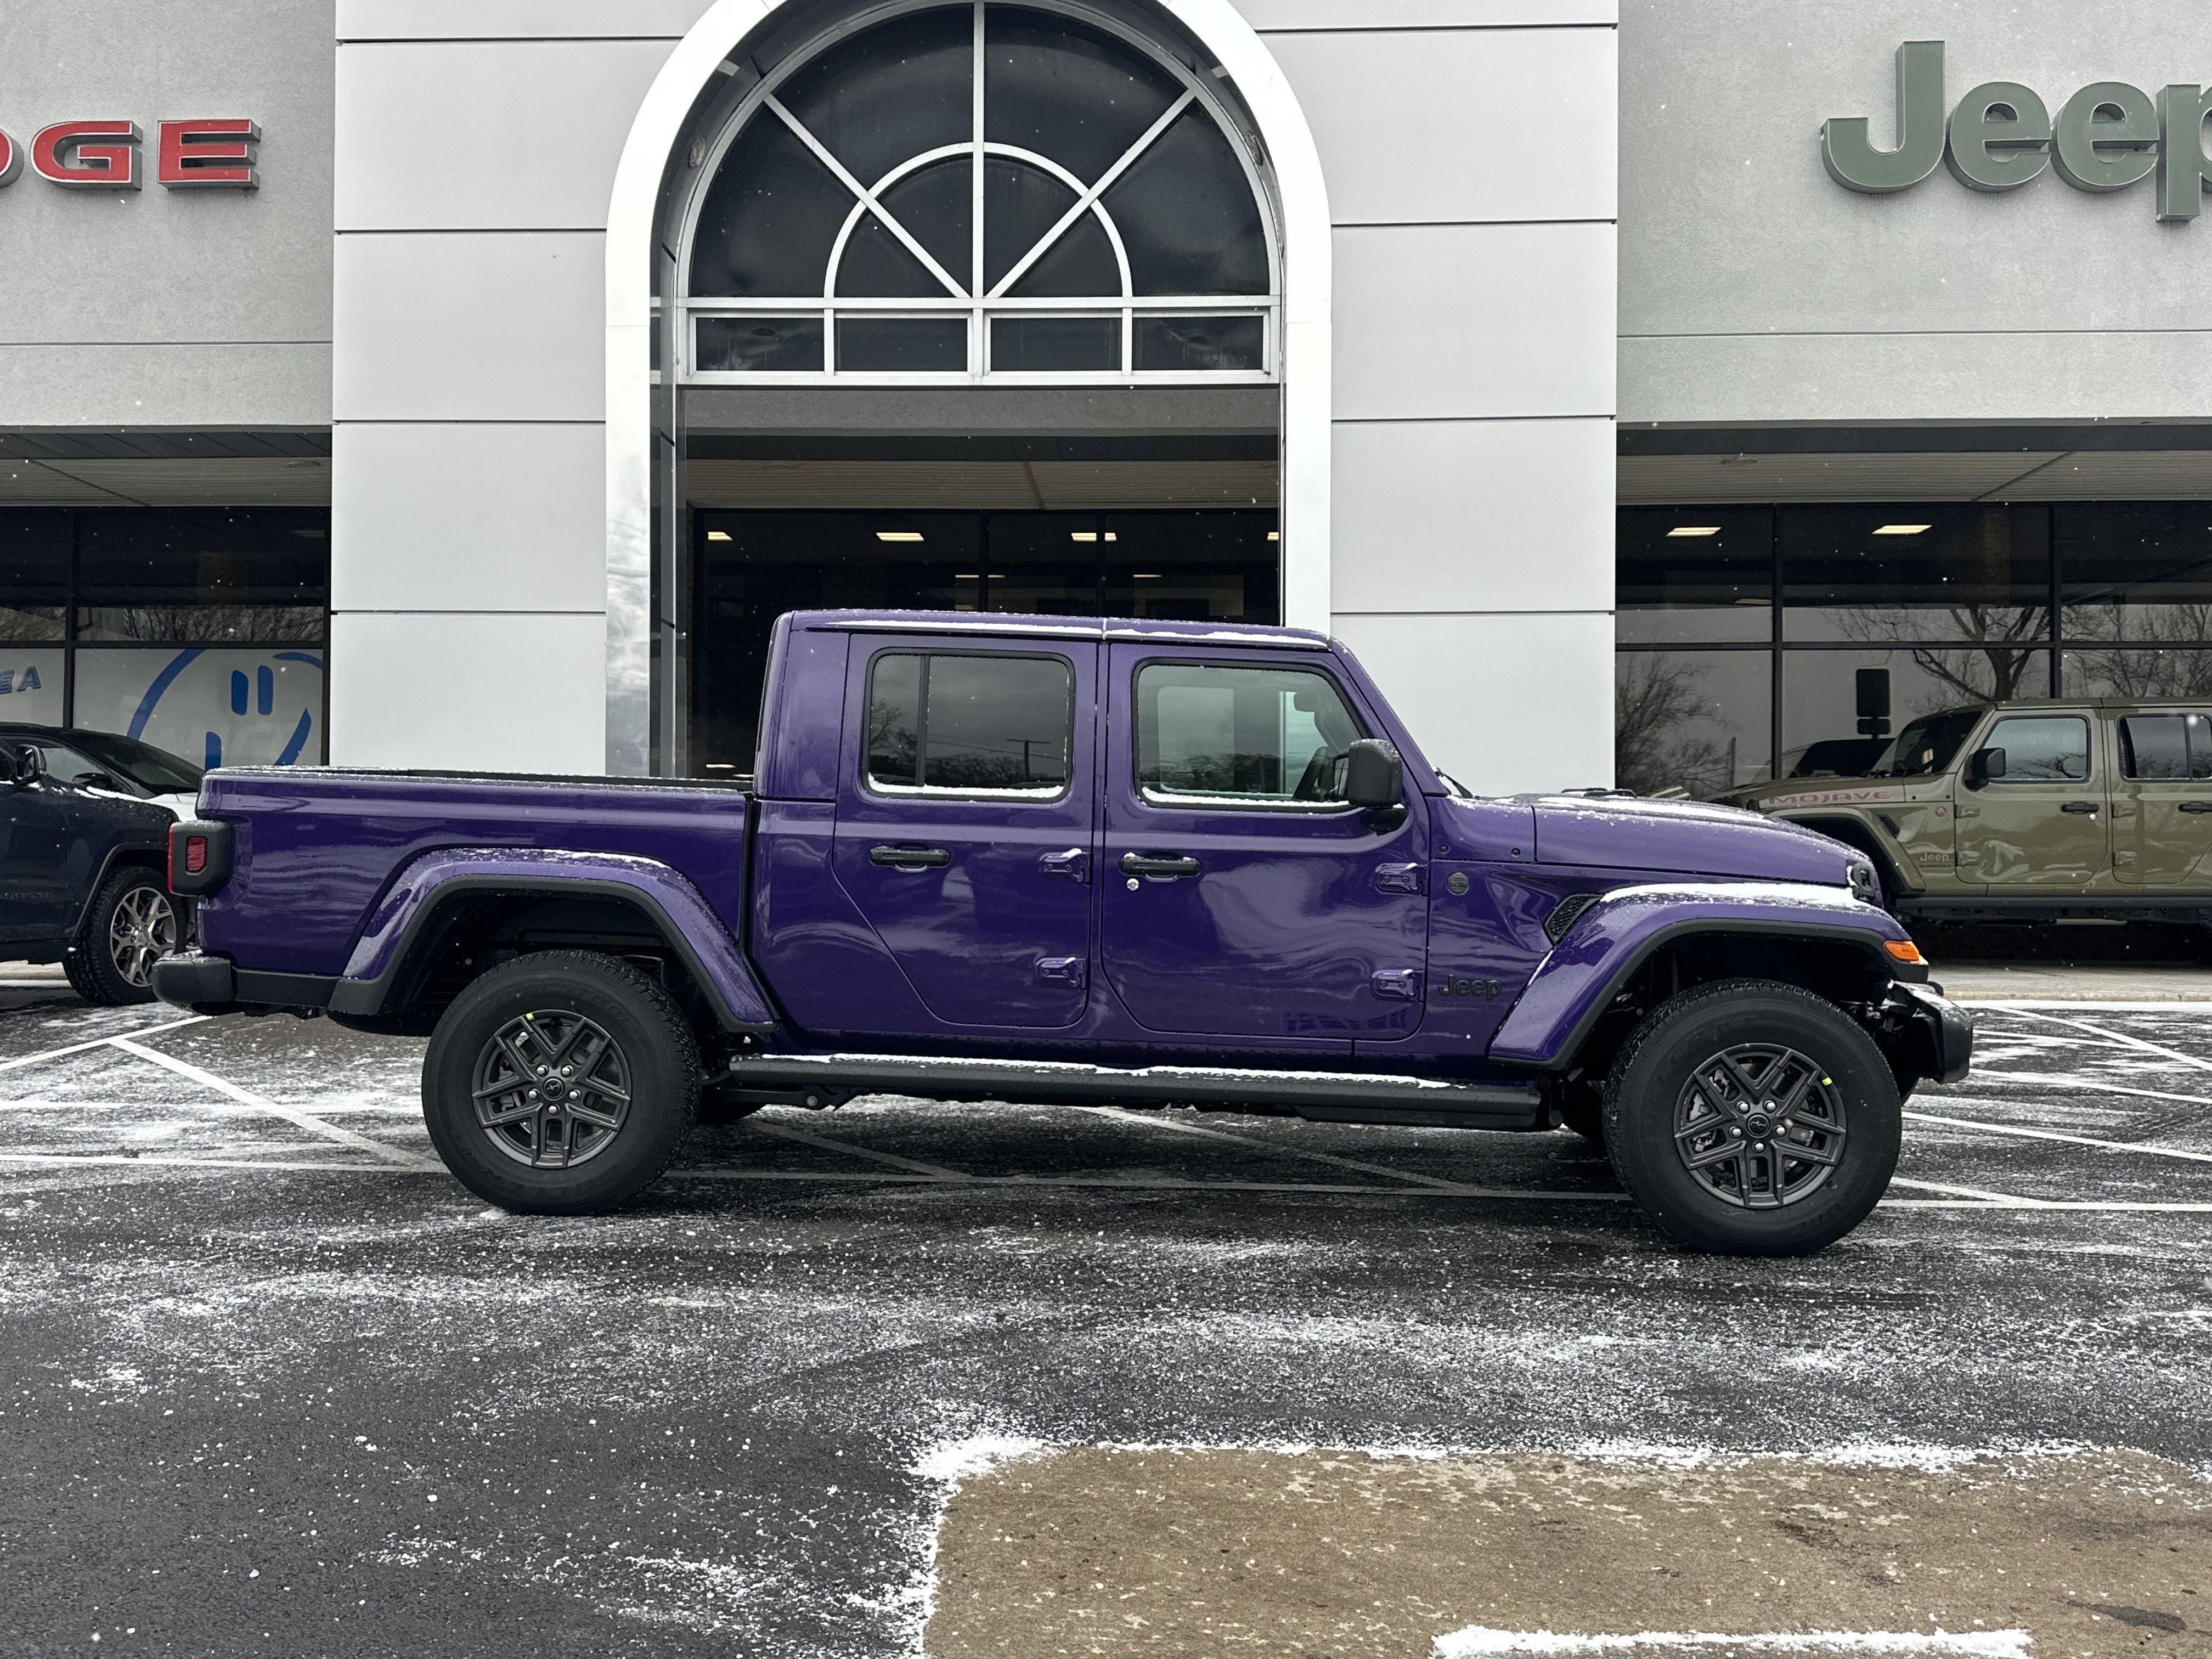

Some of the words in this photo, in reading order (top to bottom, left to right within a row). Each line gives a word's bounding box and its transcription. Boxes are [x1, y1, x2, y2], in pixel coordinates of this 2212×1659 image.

[1767, 791, 1891, 805] MOJAVE
[1920, 852, 1949, 863] Jeep
[1438, 974, 1502, 1000] Jeep
